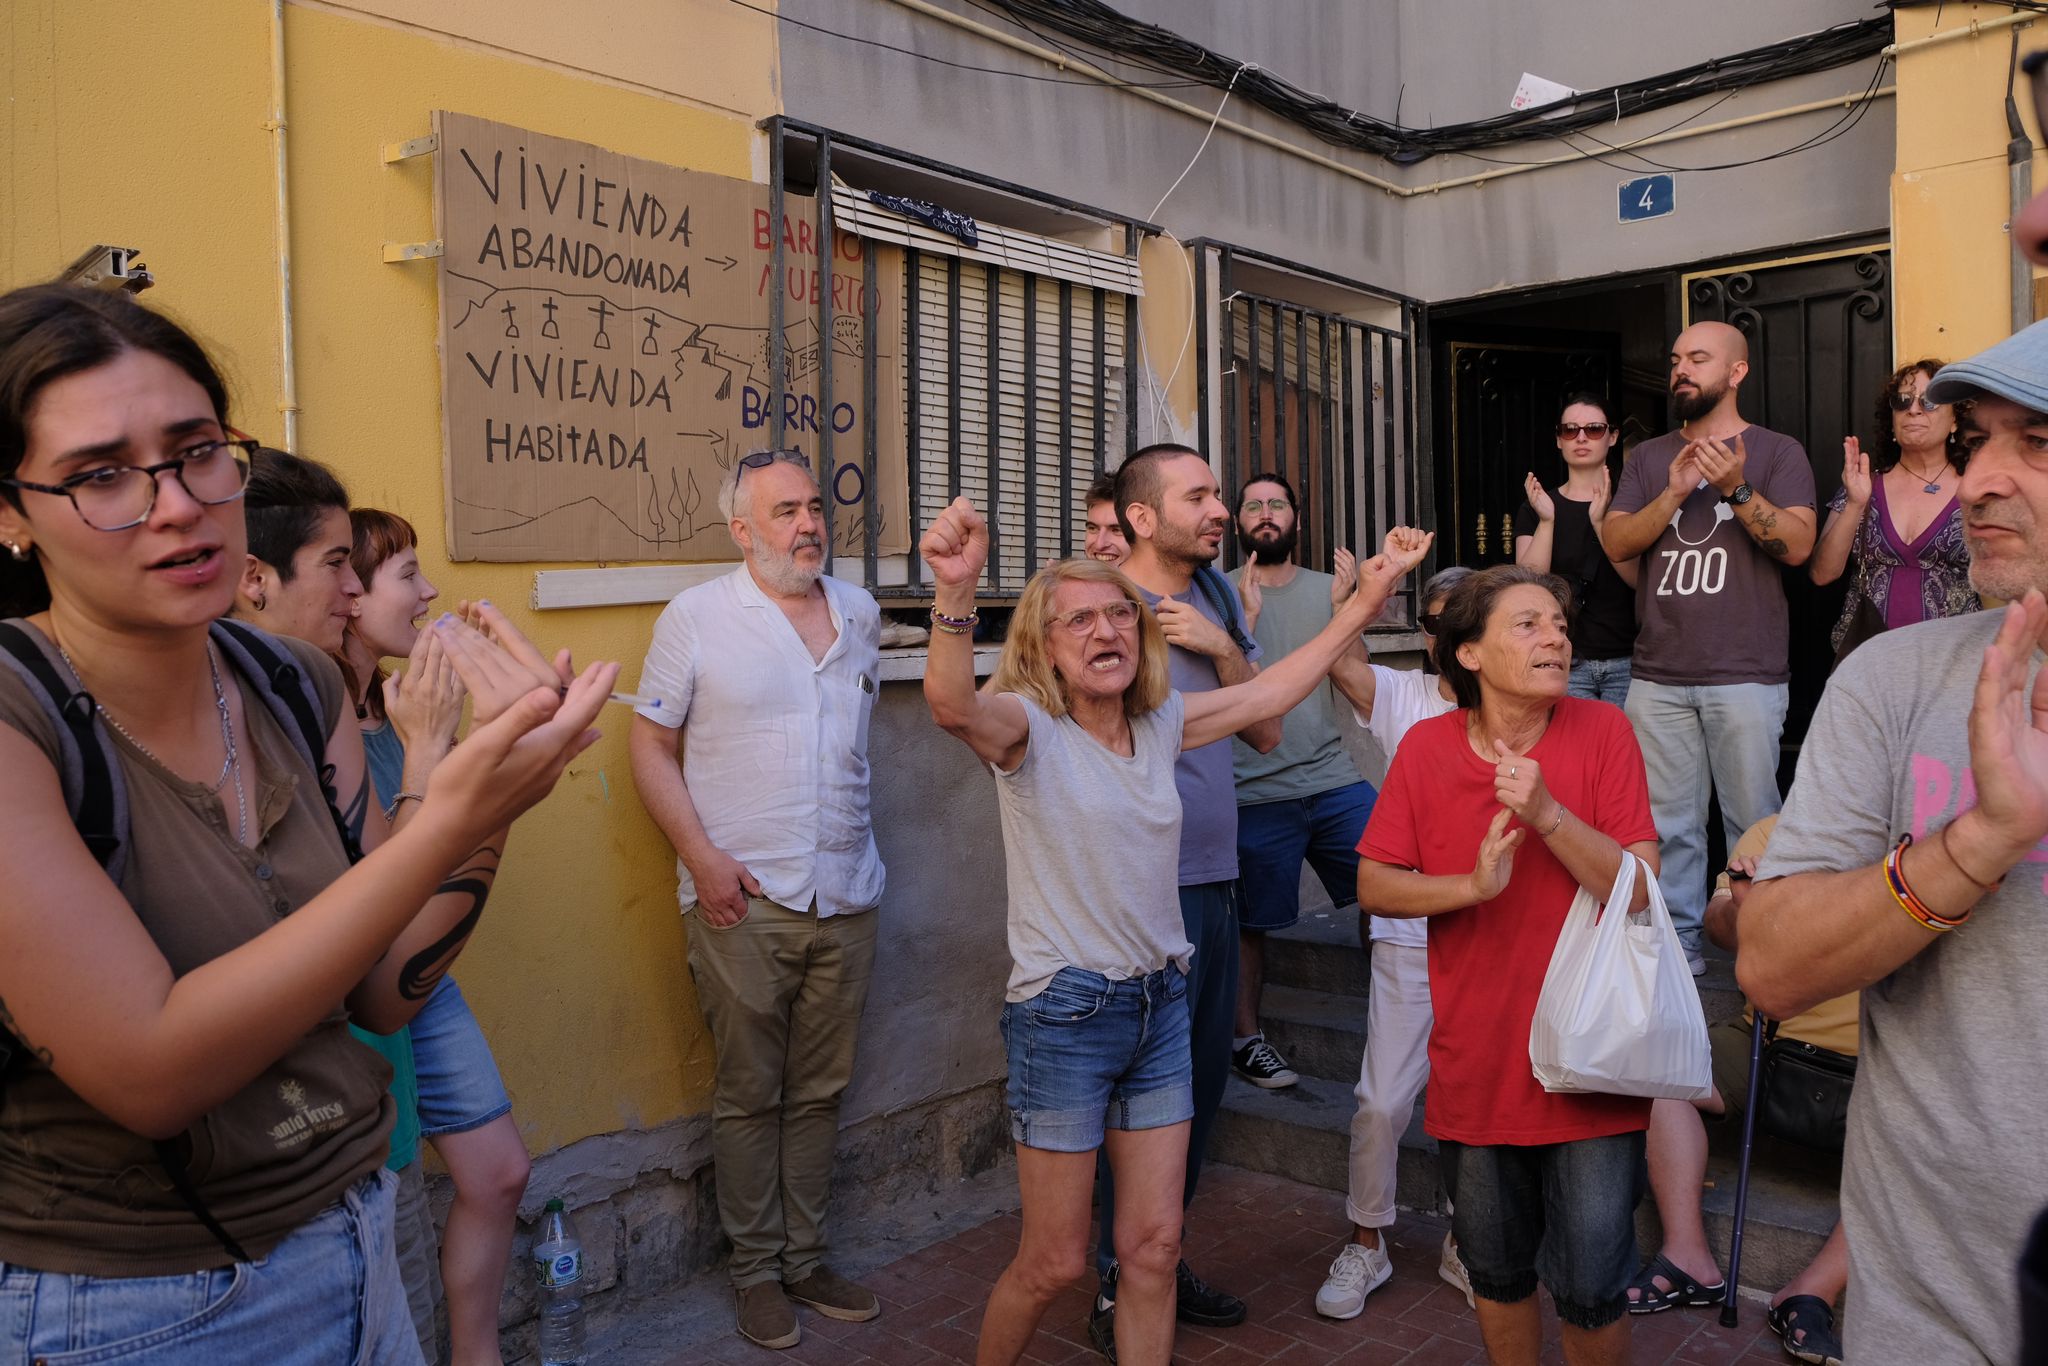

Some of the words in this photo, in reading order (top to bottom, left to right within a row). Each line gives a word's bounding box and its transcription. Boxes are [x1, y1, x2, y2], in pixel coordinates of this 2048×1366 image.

[1638, 184, 1654, 211] 4
[754, 208, 863, 262] BARIO
[478, 224, 691, 298] ABANDONADA
[742, 386, 855, 434] BARRO
[1656, 546, 1728, 596] ZOO
